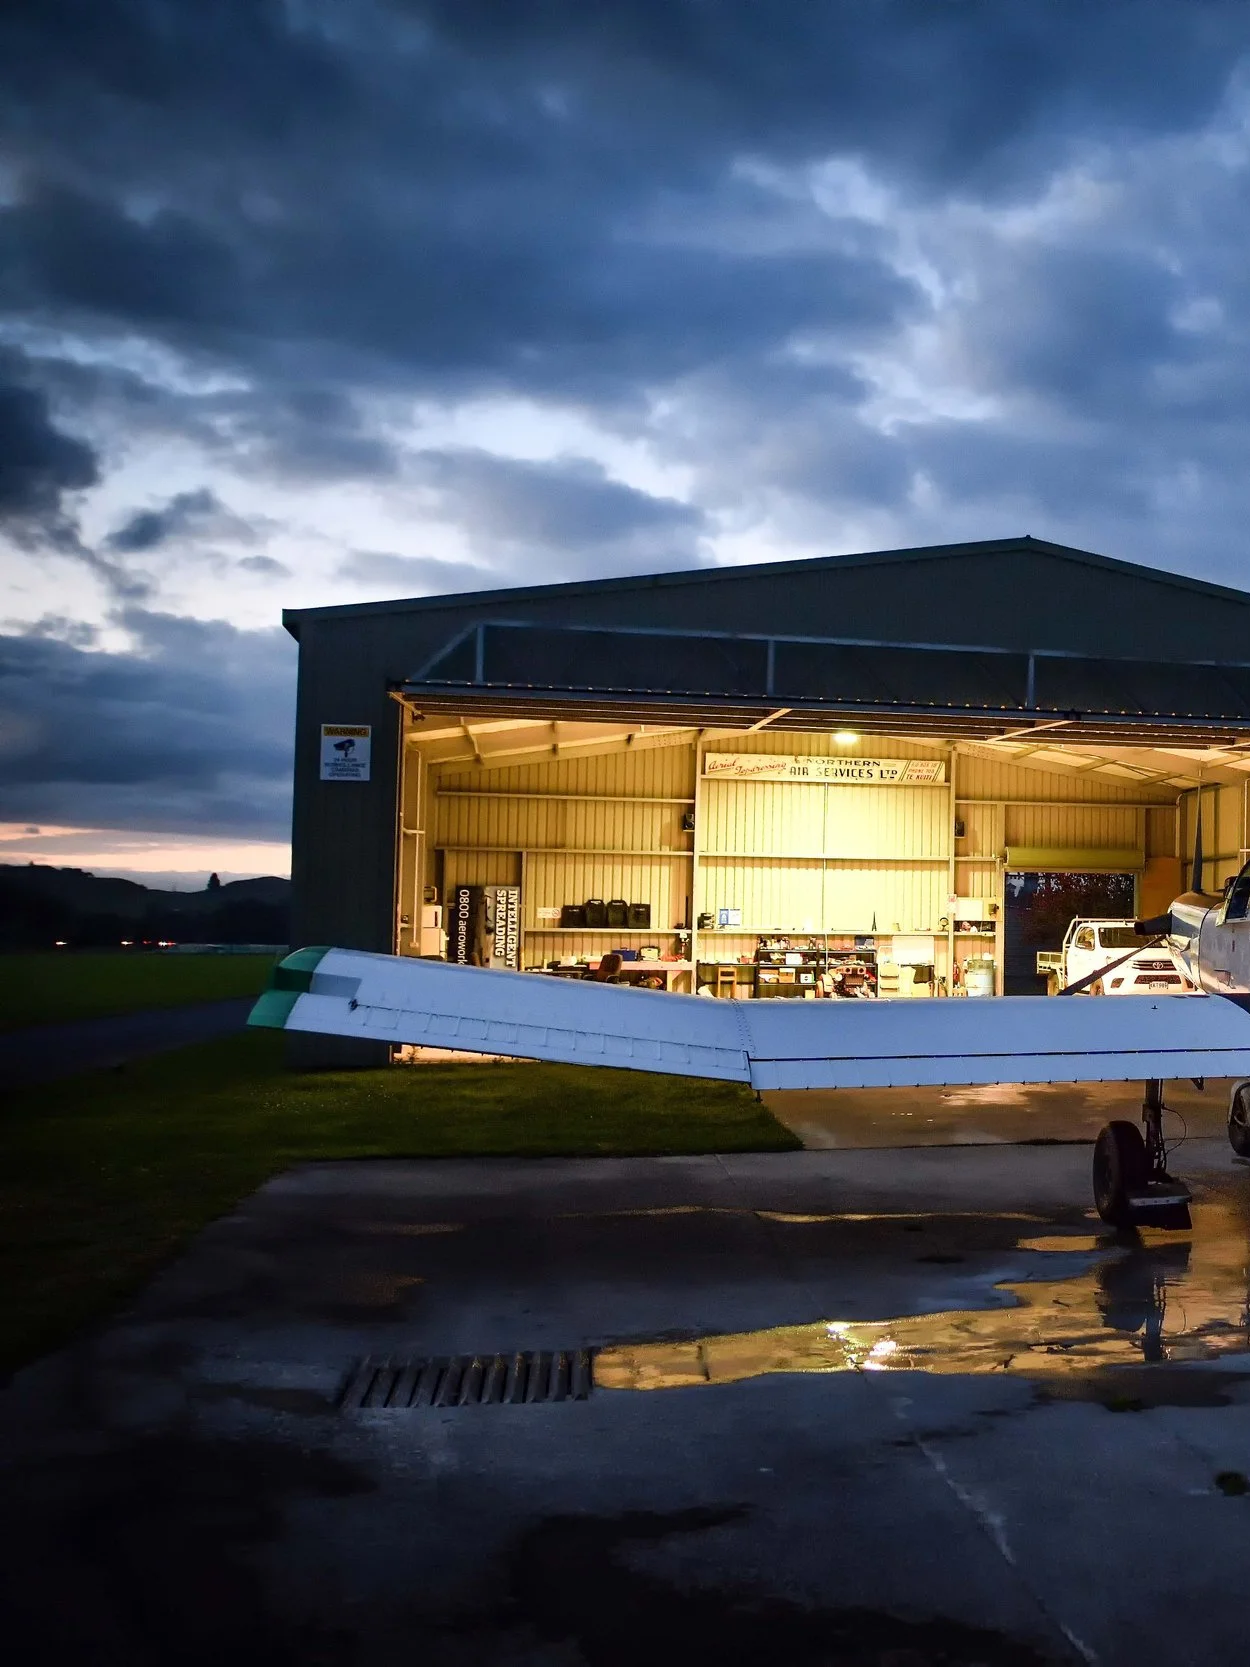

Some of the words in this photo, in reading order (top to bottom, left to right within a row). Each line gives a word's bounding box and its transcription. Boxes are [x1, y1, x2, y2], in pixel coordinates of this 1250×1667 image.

[326, 726, 369, 736] WARNING
[708, 757, 739, 771] Aerial
[735, 761, 787, 776] Topdressing
[806, 758, 881, 767] NORTHERN
[789, 766, 809, 776] AIR
[815, 767, 874, 779] SERVICES
[459, 889, 470, 919] 0800
[494, 889, 507, 957] SPREADING
[506, 889, 518, 968] INTELLIGENT
